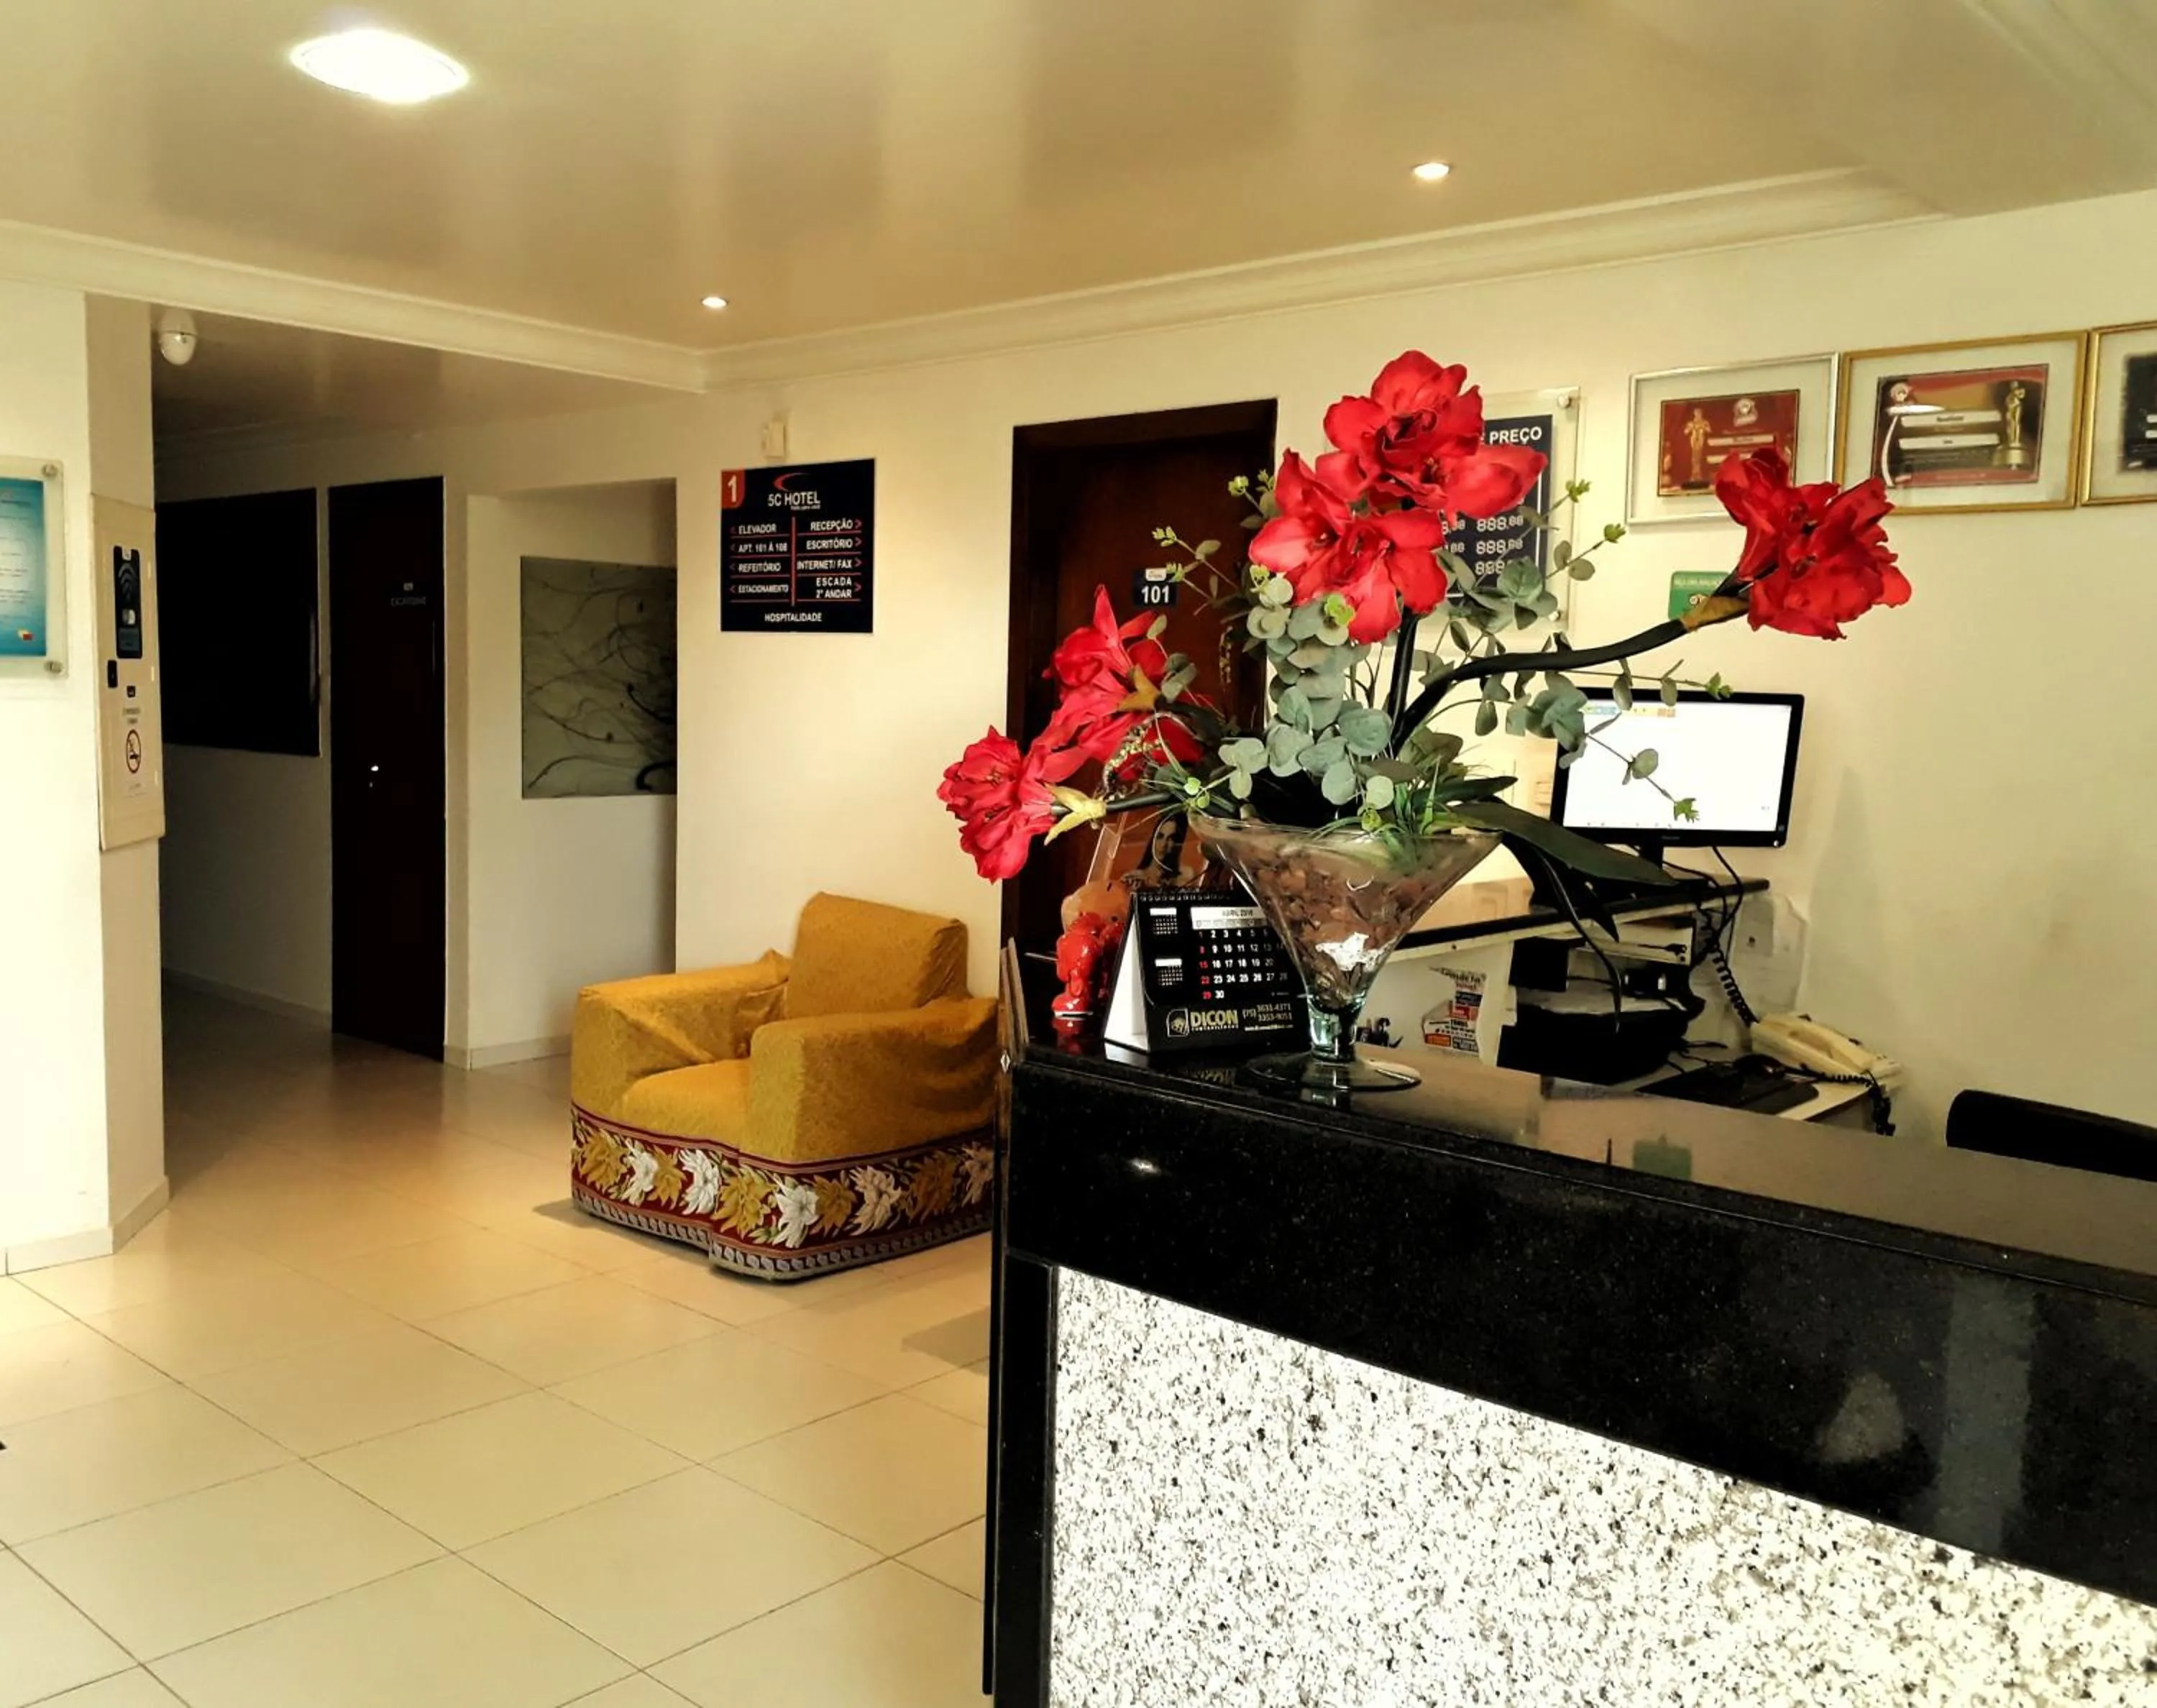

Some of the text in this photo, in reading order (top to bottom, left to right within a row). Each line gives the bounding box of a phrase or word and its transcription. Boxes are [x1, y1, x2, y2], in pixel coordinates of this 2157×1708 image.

[1489, 426, 1542, 445] PREÇO
[728, 474, 738, 502] 1
[784, 490, 821, 506] HOTEL
[738, 523, 777, 535] ELEVADOR
[810, 518, 853, 532] RECEPÇÃO
[806, 537, 853, 550] ESCRITÓRIO
[837, 559, 852, 569] FAX
[816, 577, 852, 587] ESCADA
[825, 589, 852, 599] ANDAR
[1141, 585, 1170, 604] 101
[764, 612, 823, 623] HOSPITALIDADE
[1211, 929, 1217, 938] 2
[1223, 929, 1229, 938] 3
[1212, 945, 1218, 954] 9
[1224, 944, 1233, 953] 10
[1237, 944, 1245, 952] 11
[1250, 944, 1259, 952] 12
[1212, 960, 1221, 968] 16
[1224, 959, 1234, 968] 17
[1237, 959, 1247, 968] 18
[1252, 958, 1260, 968] 19
[1213, 975, 1223, 984] 23
[1226, 974, 1236, 983] 24
[1239, 973, 1249, 983] 25
[1252, 973, 1262, 983] 26
[1266, 973, 1275, 981] 27
[1215, 990, 1224, 999] 30
[1190, 1009, 1239, 1028] DICON
